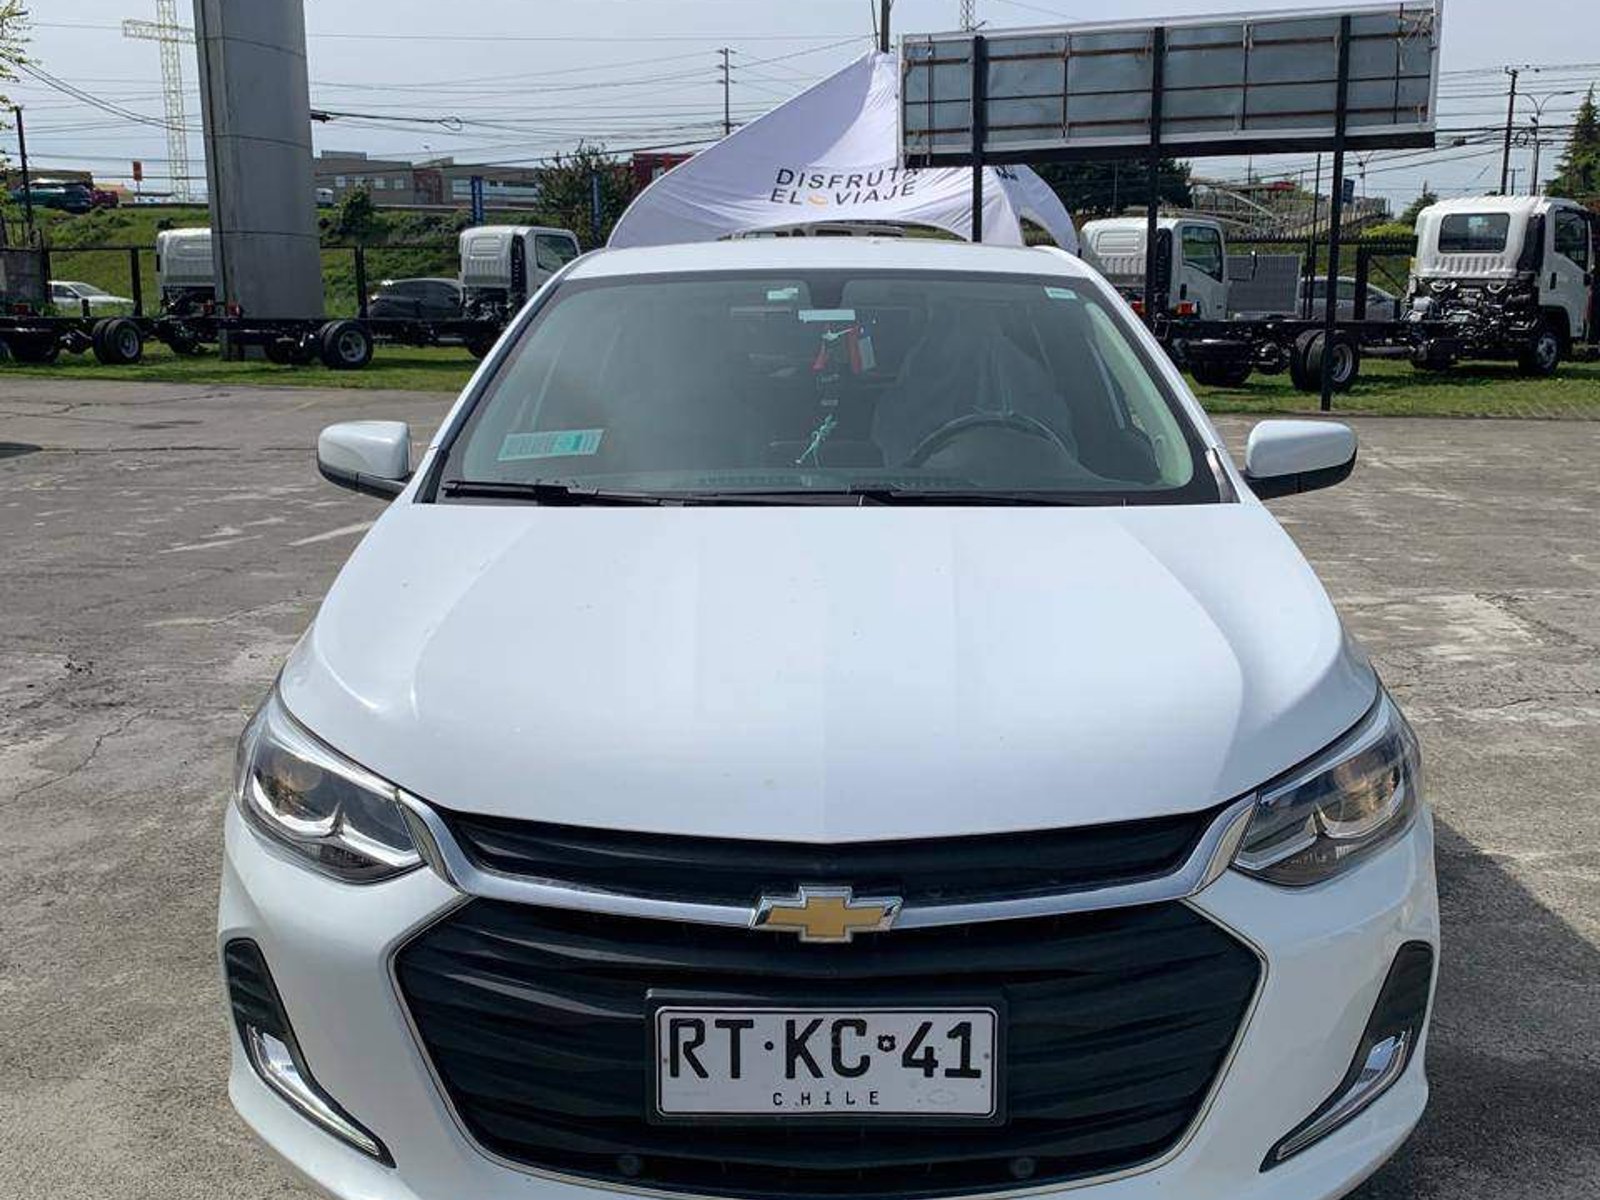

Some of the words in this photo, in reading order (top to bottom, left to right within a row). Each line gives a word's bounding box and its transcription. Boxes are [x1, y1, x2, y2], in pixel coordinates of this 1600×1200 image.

[770, 187, 802, 205] EL
[835, 180, 916, 205] VIAJE
[772, 1091, 880, 1106] CHILE
